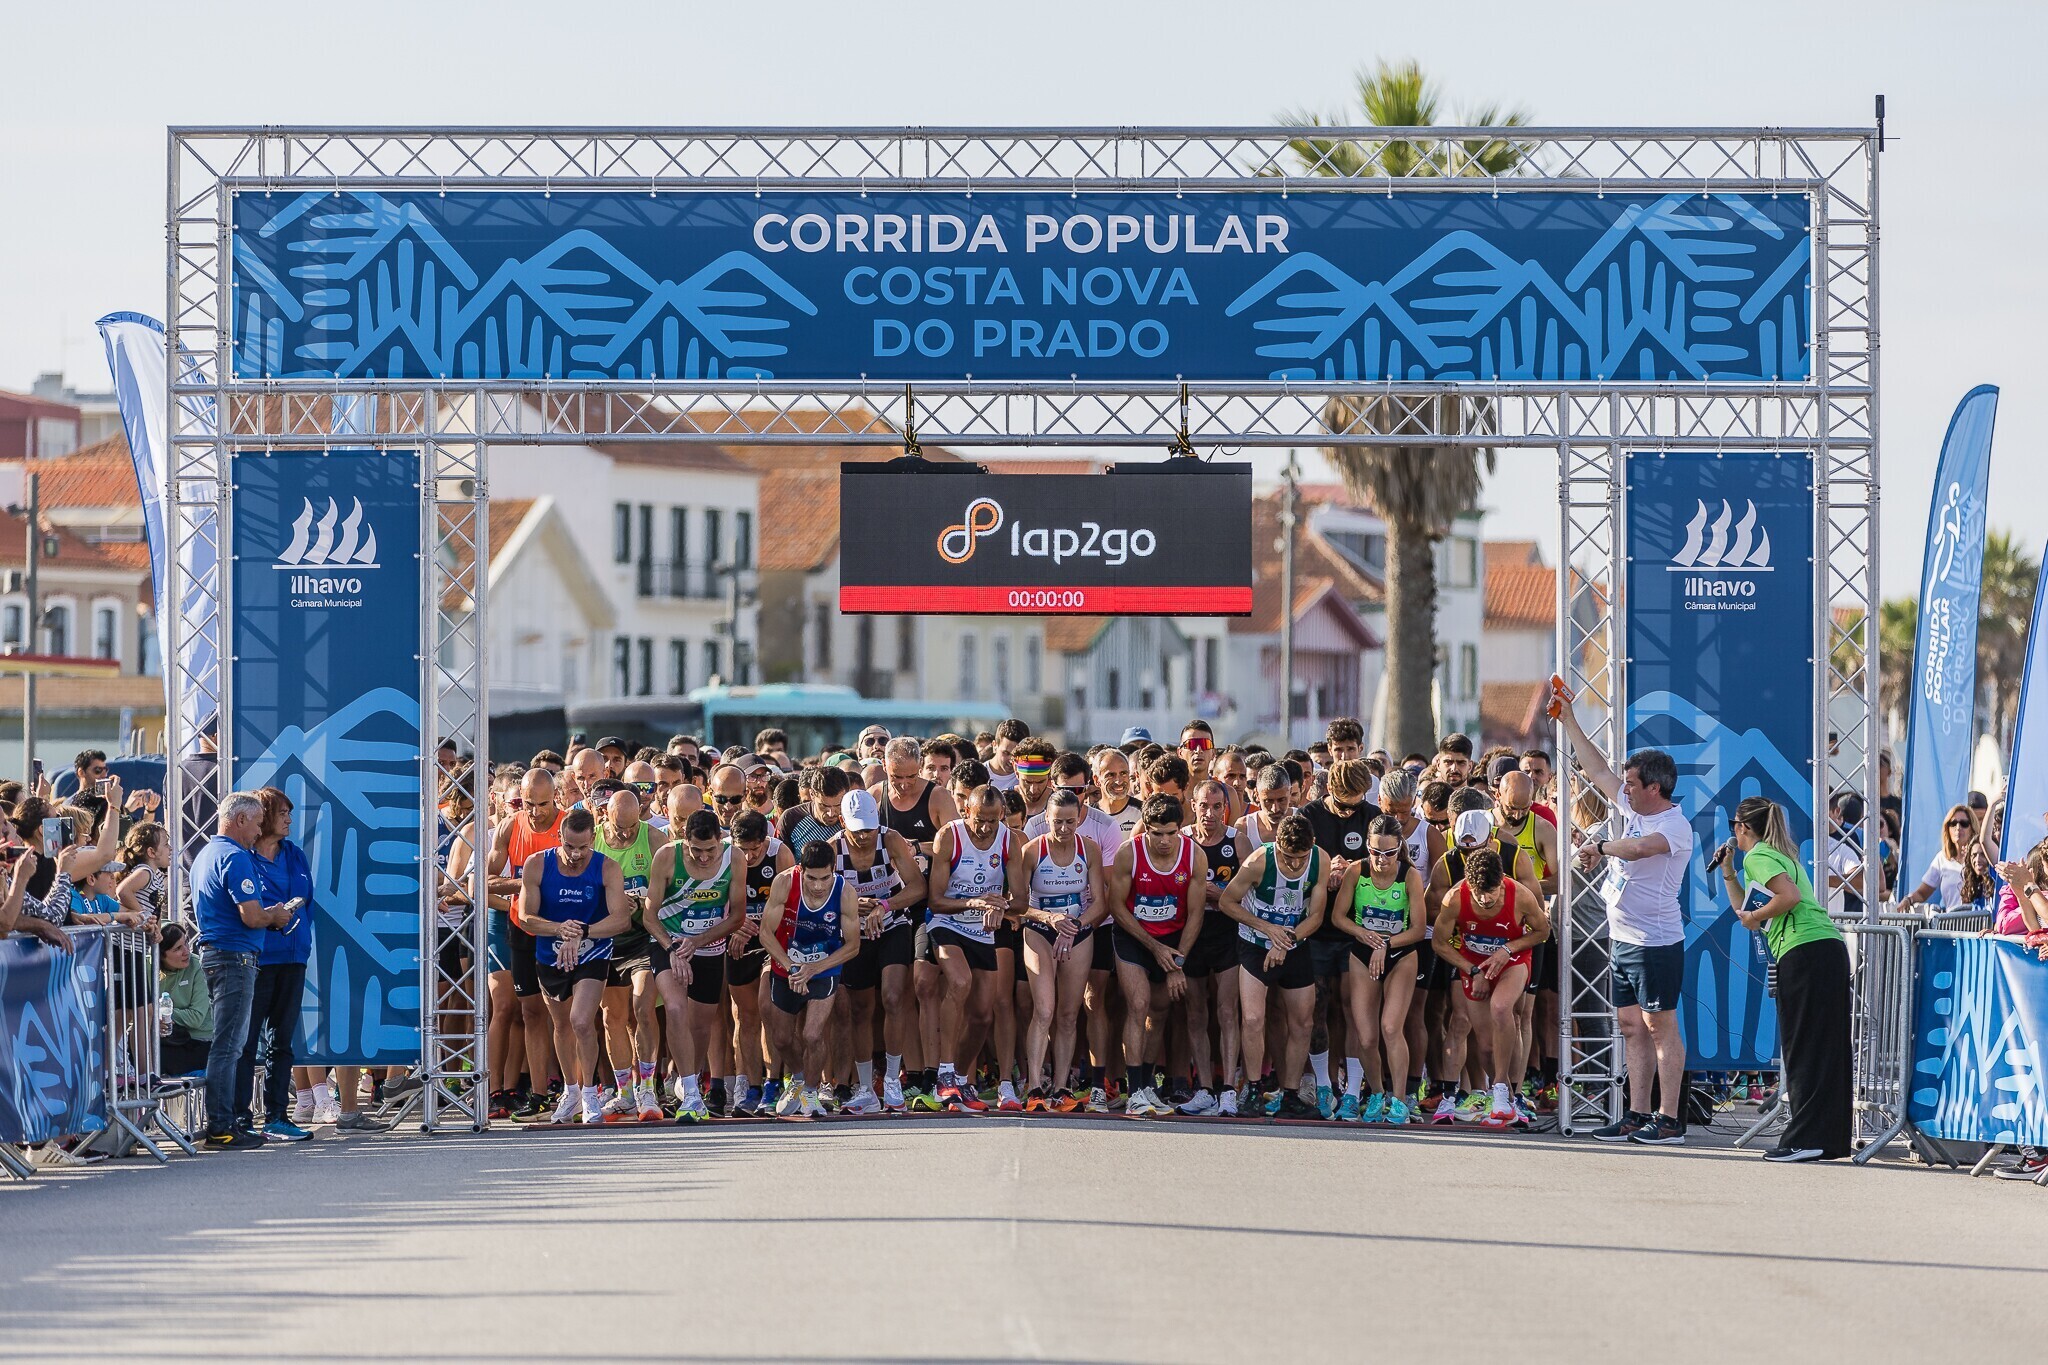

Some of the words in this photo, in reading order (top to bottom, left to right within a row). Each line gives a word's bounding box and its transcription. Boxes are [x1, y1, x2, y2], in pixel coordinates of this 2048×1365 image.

[753, 213, 1009, 254] CORRIDA
[1026, 214, 1290, 254] POPULAR
[843, 266, 1025, 305] COSTA
[1043, 267, 1199, 305] NOVA
[873, 319, 955, 358] DO
[974, 319, 1170, 358] PRADO
[1010, 520, 1157, 565] lap2go
[290, 599, 323, 608] Câmara
[324, 599, 362, 608] Municipal
[1008, 590, 1085, 607] 00:00:00
[1684, 601, 1717, 610] Câmara
[1718, 602, 1756, 611] Municipal
[1924, 597, 1941, 700] CORRIDA
[1932, 597, 1951, 706] POPULAR
[702, 919, 715, 928] 28
[1152, 906, 1170, 916] 927
[803, 953, 821, 963] 129
